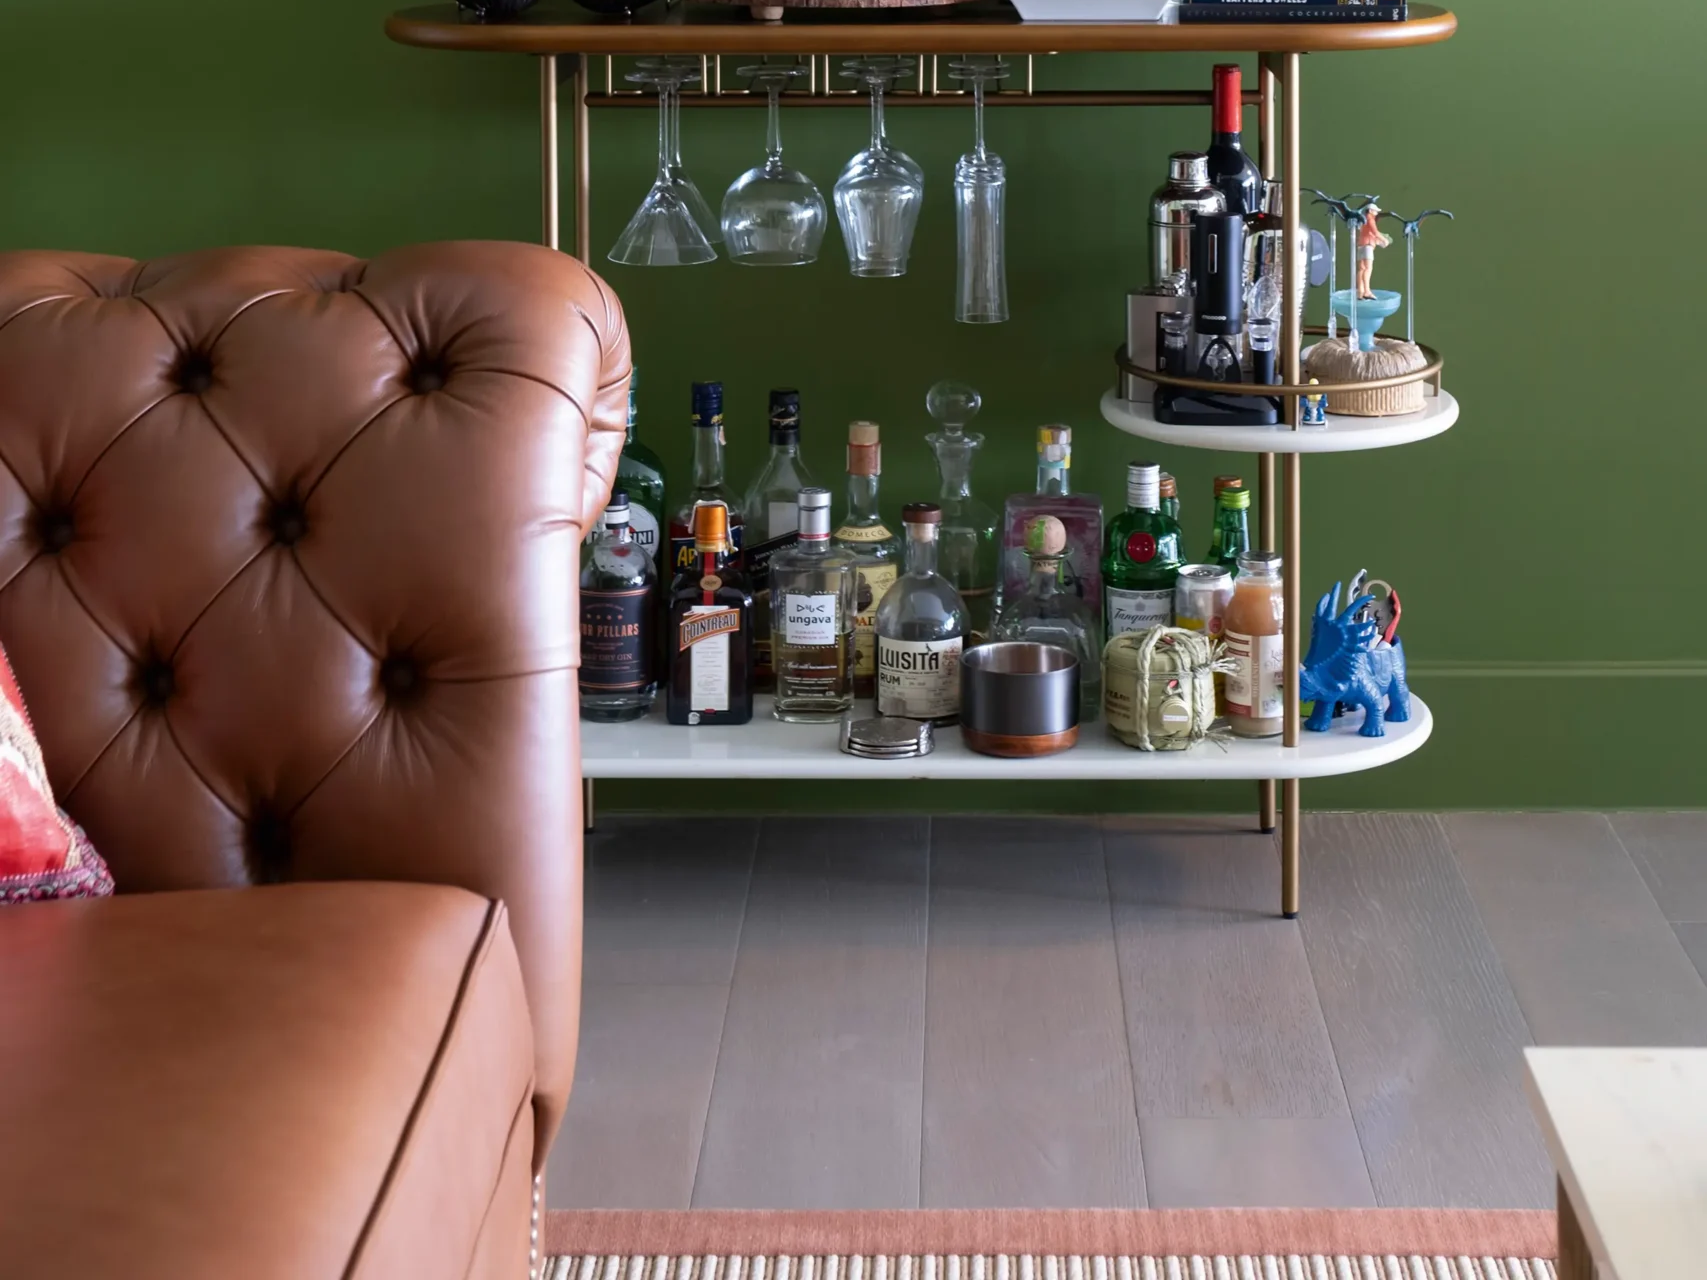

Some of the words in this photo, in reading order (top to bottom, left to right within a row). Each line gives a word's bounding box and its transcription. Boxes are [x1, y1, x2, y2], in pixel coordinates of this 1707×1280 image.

[840, 528, 886, 539] DOMECQ
[788, 615, 832, 626] ungava
[1114, 607, 1169, 625] Tanqueray
[597, 622, 640, 638] PILLARS
[682, 613, 737, 644] COINTREAU
[616, 652, 633, 661] GIN
[880, 646, 940, 671] LUISITA
[880, 672, 901, 686] RUM
